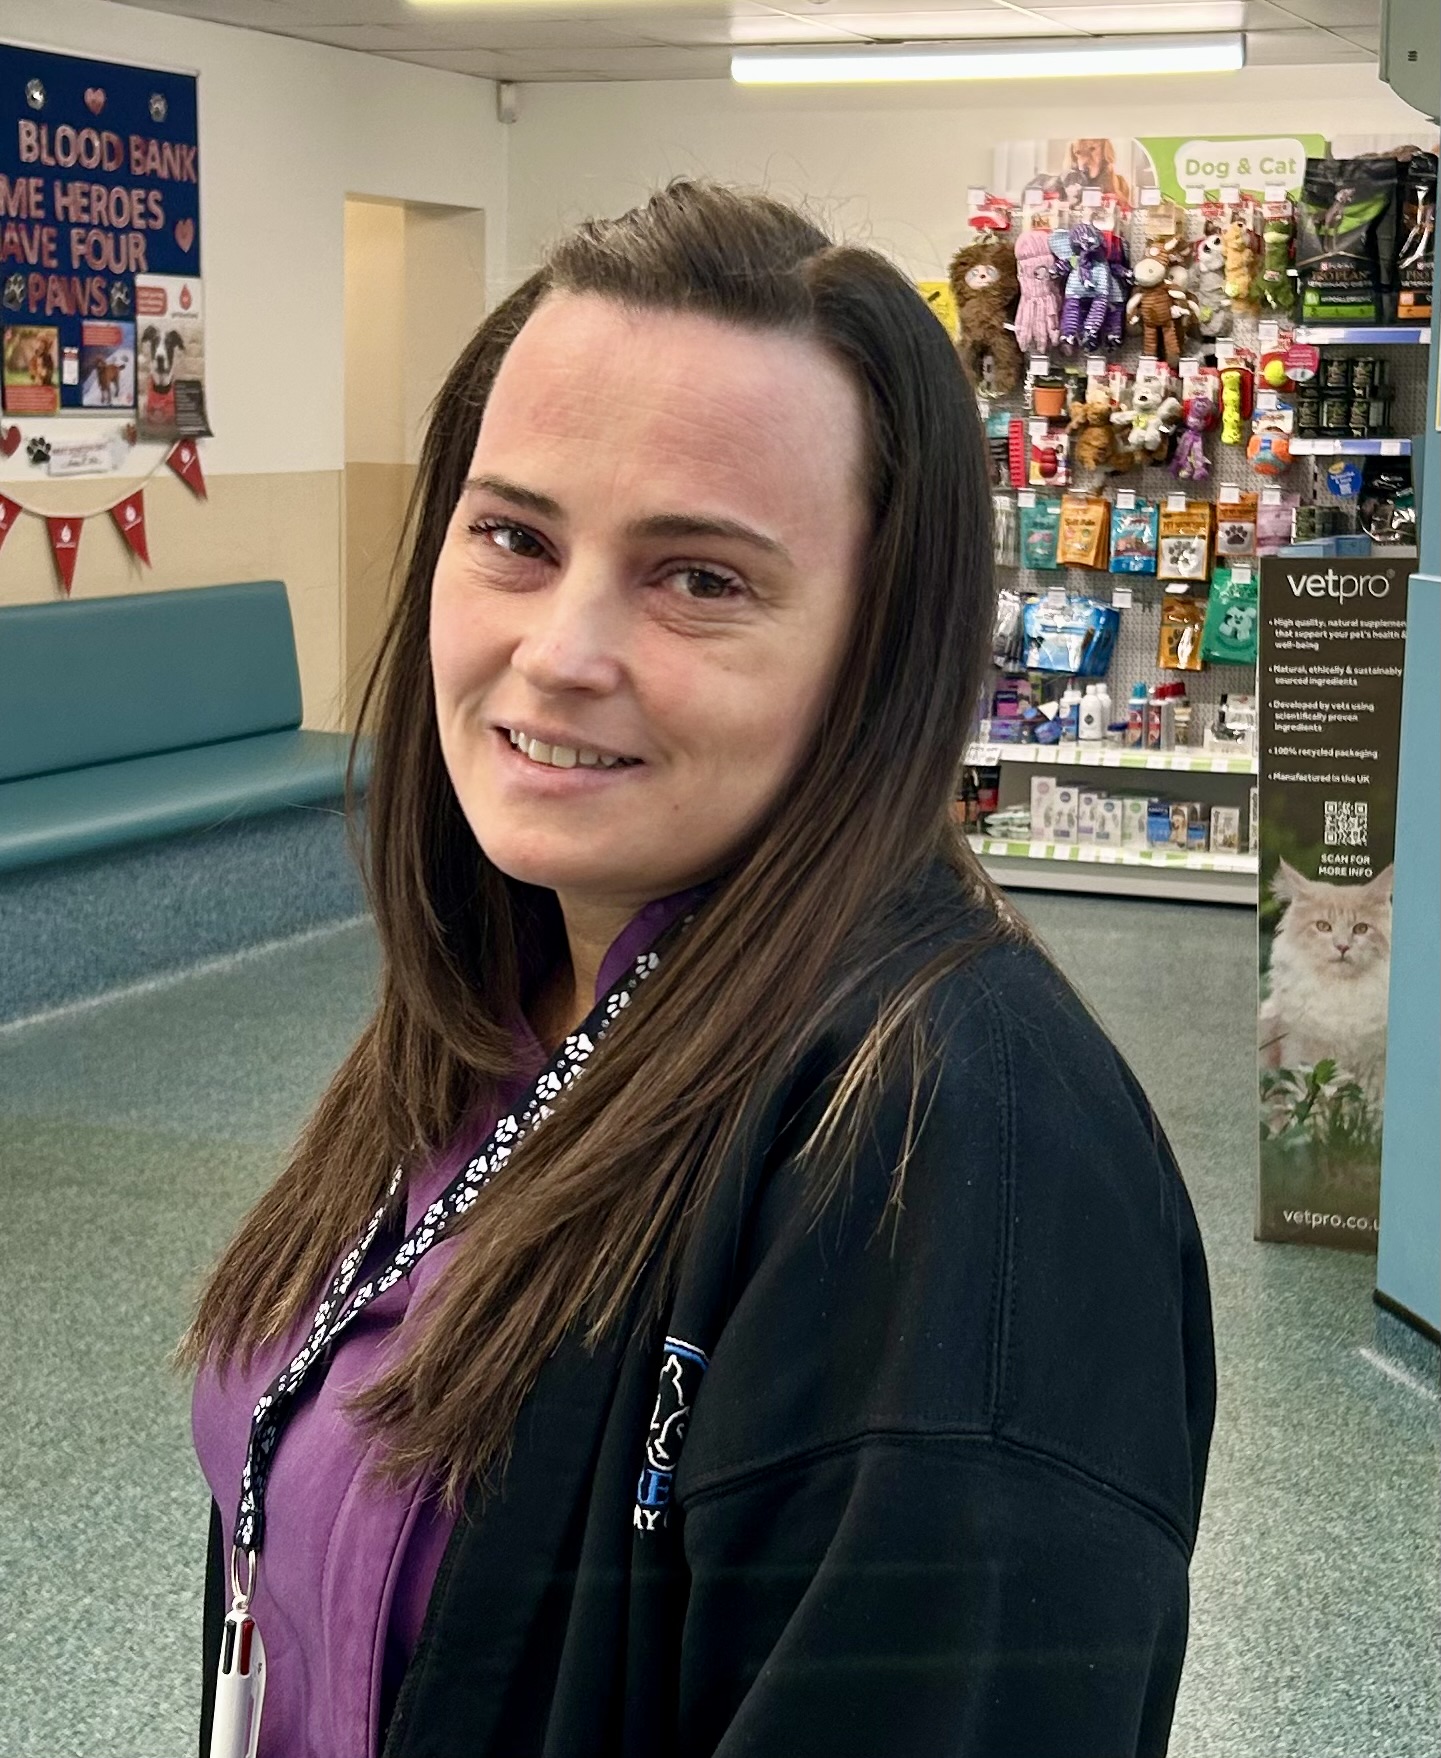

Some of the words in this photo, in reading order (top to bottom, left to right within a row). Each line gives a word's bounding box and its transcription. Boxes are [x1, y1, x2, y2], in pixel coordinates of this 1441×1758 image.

[18, 118, 124, 172] BLOOD
[129, 134, 198, 184] BANK
[1185, 158, 1230, 179] Dog
[1237, 157, 1252, 175] &
[1259, 156, 1297, 175] Cat
[54, 180, 164, 231] HEROES
[70, 227, 148, 275] FOUR
[28, 272, 108, 318] PAWS
[1286, 568, 1390, 605] vetpro
[1273, 618, 1293, 629] High
[1328, 619, 1358, 628] natural
[1275, 630, 1293, 638] that
[1295, 631, 1327, 640] support
[1328, 632, 1348, 641] your
[1373, 631, 1399, 639] health
[1275, 641, 1319, 651] well-being
[1309, 665, 1344, 677] ethically
[1346, 665, 1353, 674] &
[1354, 666, 1402, 677] sustainably
[1275, 677, 1308, 686] sourced
[1309, 677, 1358, 687] ingredients
[1273, 700, 1318, 710] Developed
[1319, 701, 1330, 711] by
[1331, 702, 1350, 710] vets
[1351, 702, 1375, 712] using
[1275, 712, 1327, 722] scientifically
[1328, 714, 1358, 722] proven
[1274, 747, 1297, 756] 100%
[1298, 748, 1334, 758] recycled
[1335, 748, 1378, 760] packaging
[1273, 772, 1331, 782] Manufactured
[1332, 774, 1340, 782] in
[1341, 774, 1356, 784] the
[1357, 774, 1371, 785] UK
[1321, 853, 1348, 865] SCAN
[1350, 854, 1371, 865] FOR
[1318, 866, 1347, 877] MORE
[1349, 867, 1373, 878] INFO
